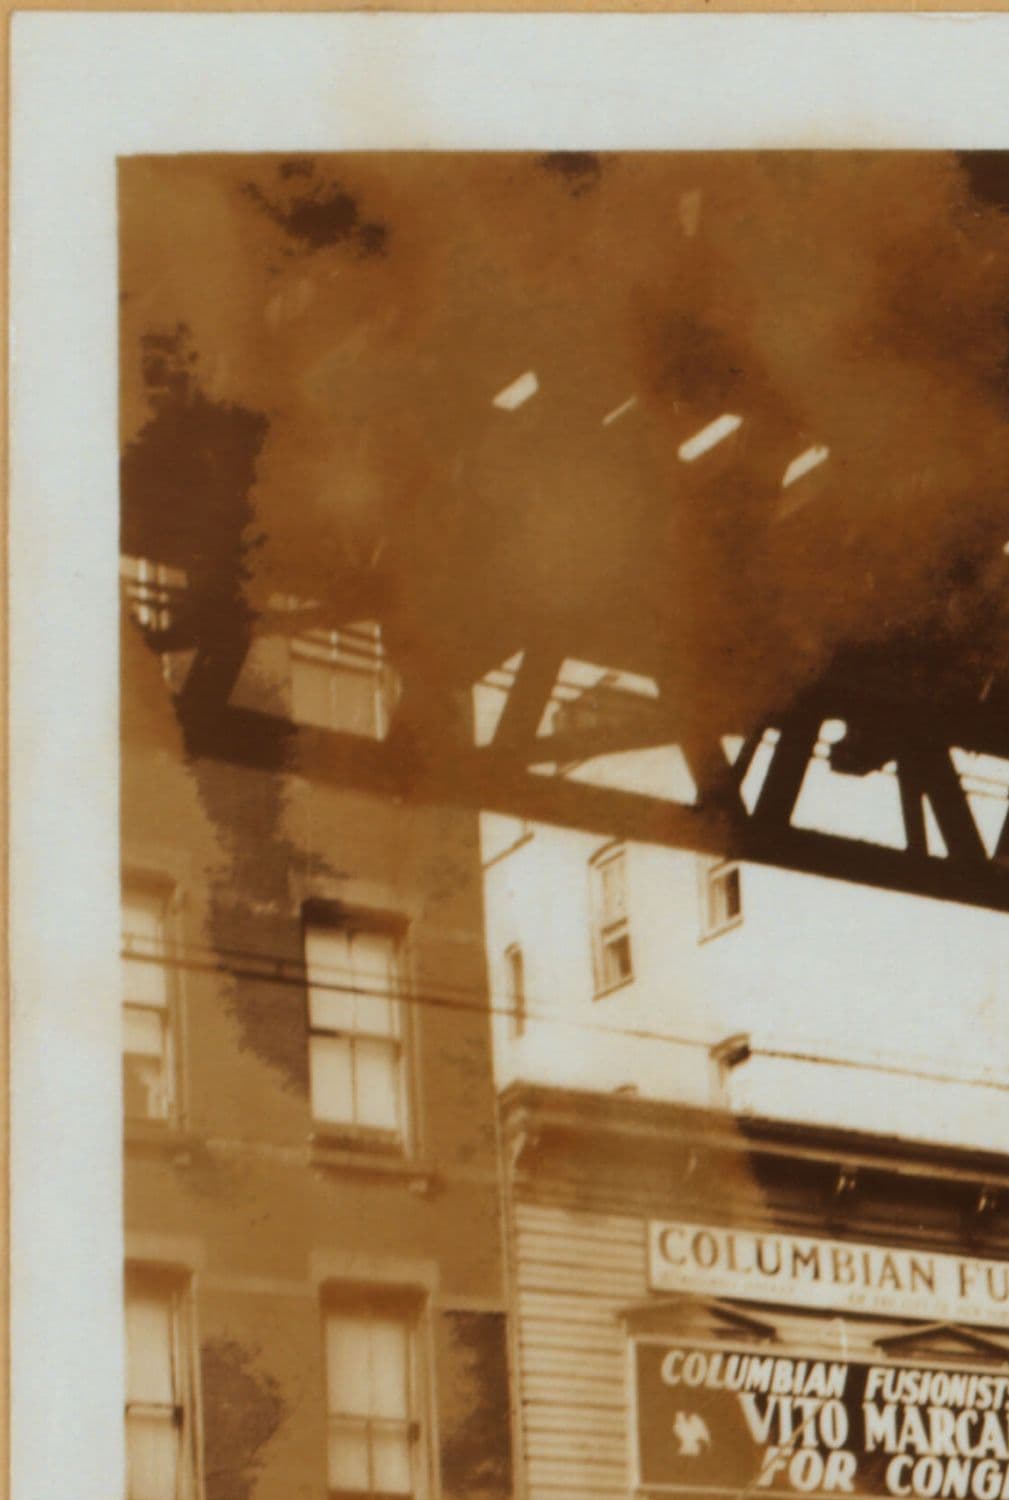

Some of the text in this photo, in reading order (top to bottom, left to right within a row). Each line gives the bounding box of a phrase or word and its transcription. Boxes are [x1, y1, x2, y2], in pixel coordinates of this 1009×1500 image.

[657, 1228, 936, 1297] COLUMBIAN
[661, 1349, 848, 1398] COLUMBIAN
[737, 1391, 848, 1450] VITO
[757, 1445, 858, 1494] FOR
